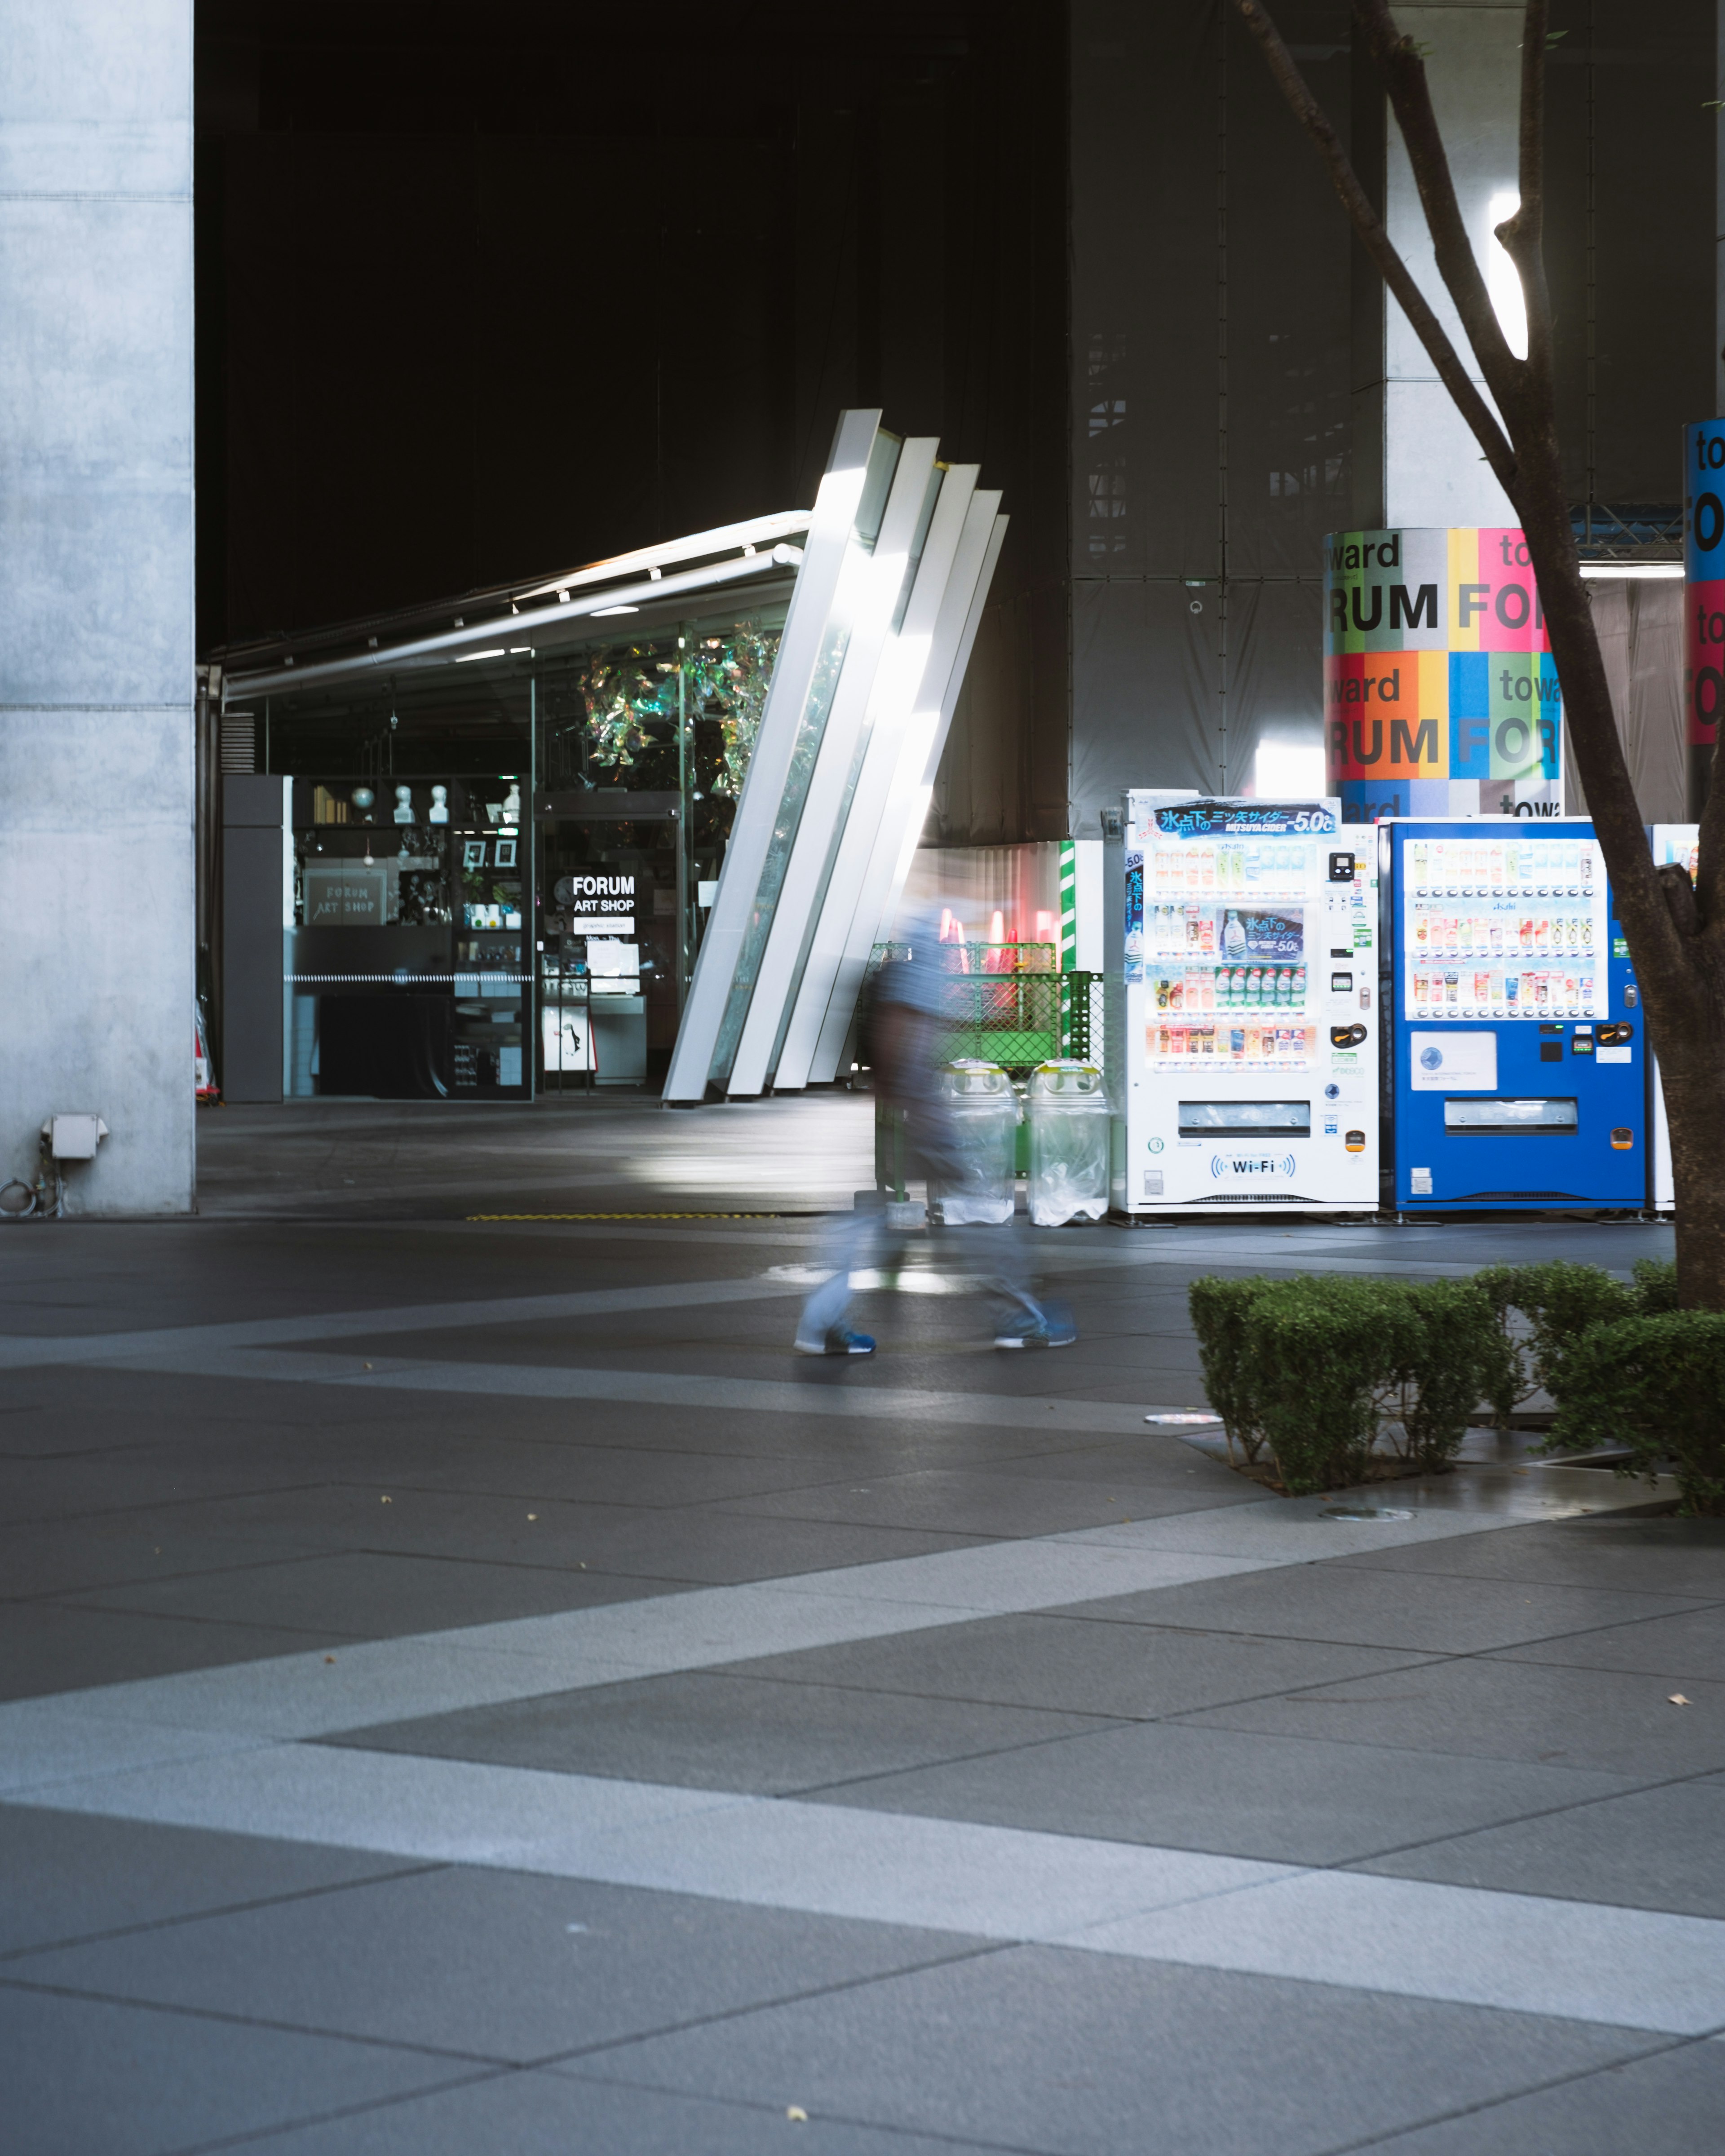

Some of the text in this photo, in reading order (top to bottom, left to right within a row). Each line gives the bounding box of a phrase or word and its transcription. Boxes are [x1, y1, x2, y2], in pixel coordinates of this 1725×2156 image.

[1459, 718, 1561, 764] FOR
[1161, 810, 1212, 831] 氷点下の
[1211, 811, 1289, 823] 三ツ矢サイダー
[1261, 823, 1287, 832] CIDER
[573, 876, 635, 895] FORUM
[1130, 871, 1143, 911] 氷点下の
[327, 886, 368, 899] FORUM
[318, 901, 374, 914] ART SHOP
[574, 899, 635, 912] ART SHOP
[1493, 902, 1516, 910] Asahi
[1246, 917, 1286, 932] 氷点下の
[1232, 1160, 1274, 1173] Wi-Fi
